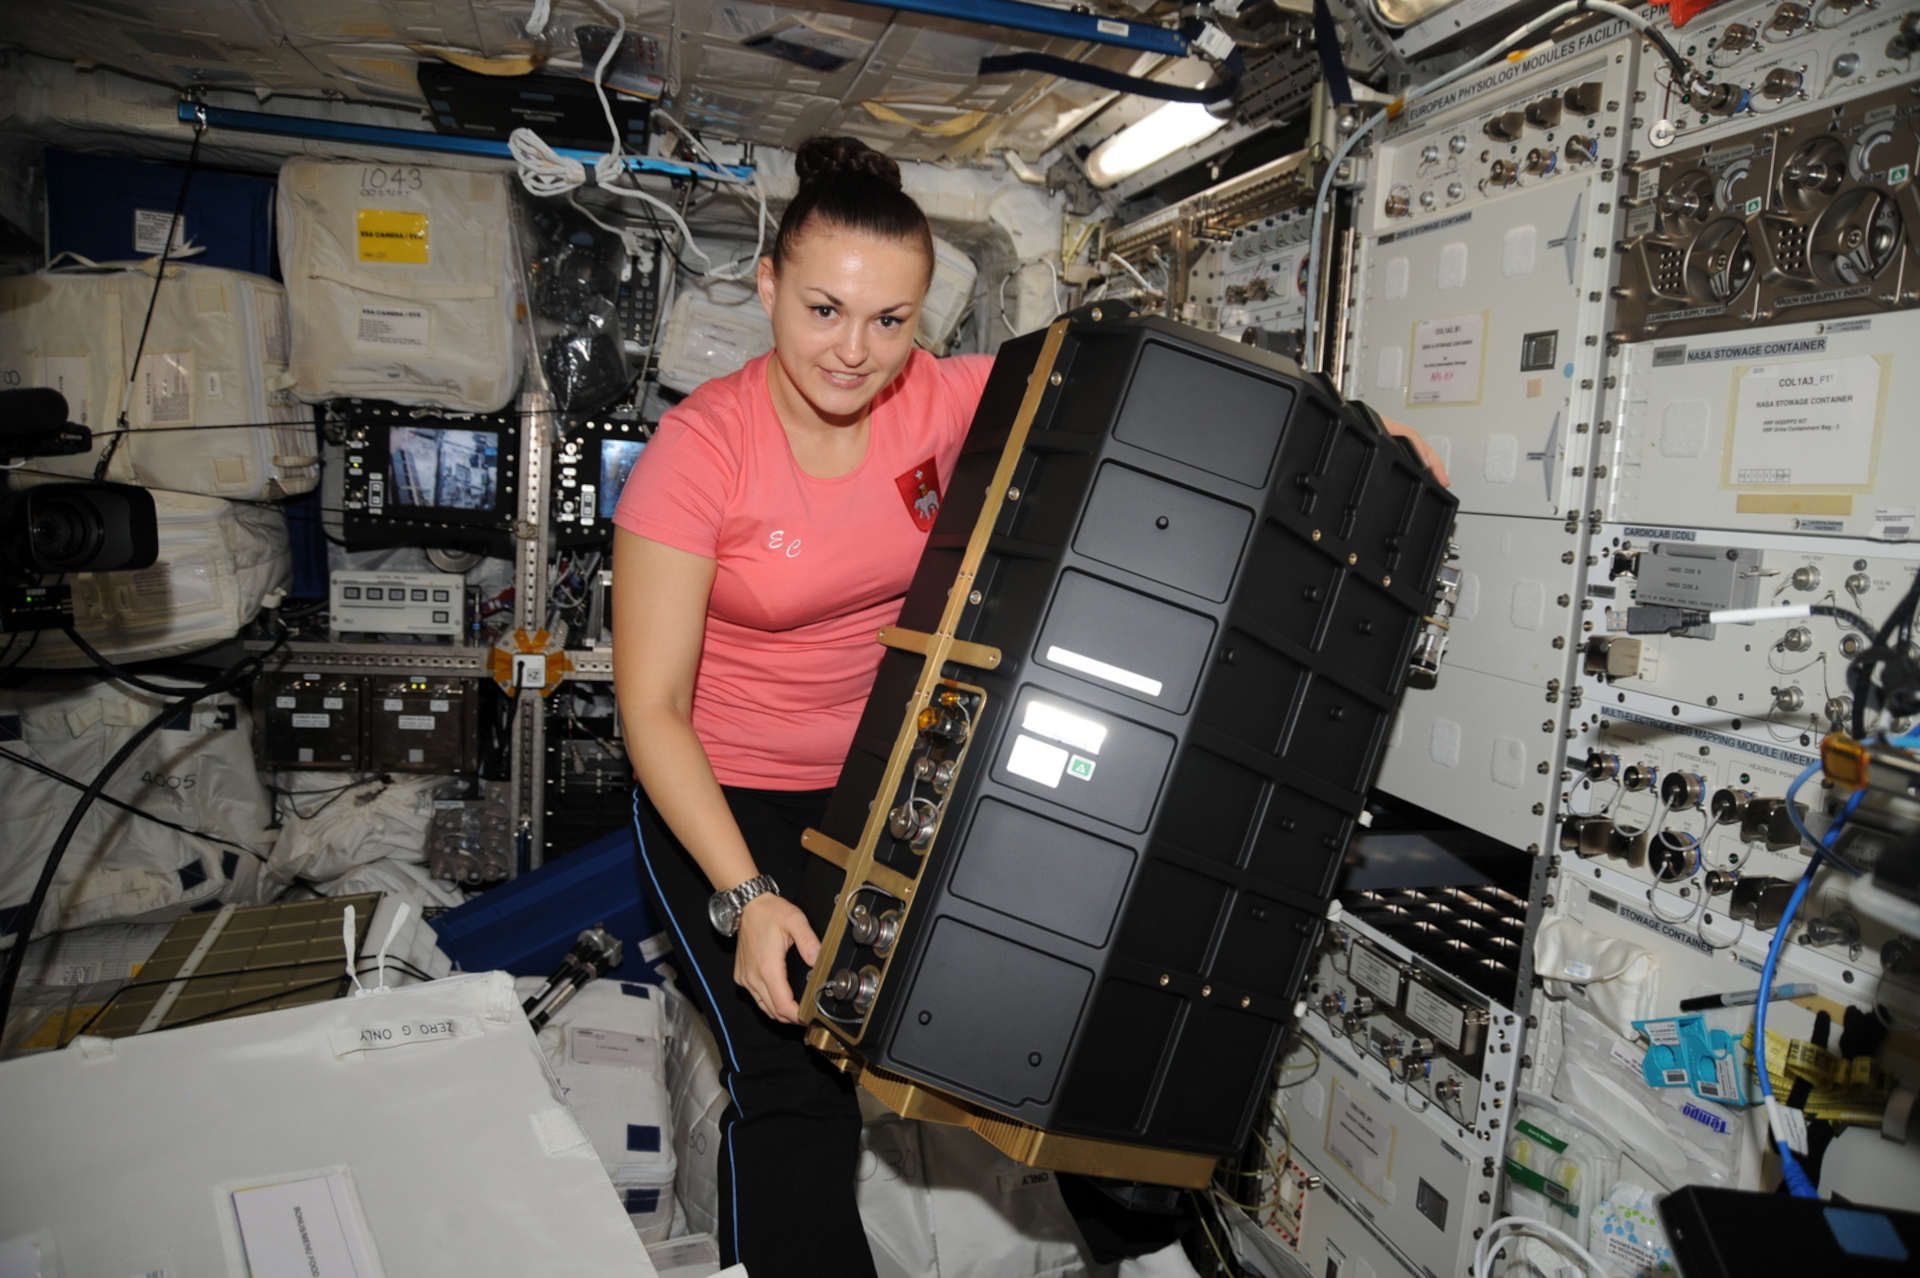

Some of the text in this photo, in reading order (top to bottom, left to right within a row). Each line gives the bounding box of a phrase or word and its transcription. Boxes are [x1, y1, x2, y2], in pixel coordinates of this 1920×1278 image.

[1409, 93, 1458, 120] EUROPEAN
[1457, 65, 1521, 103] PHYSIOLOGY
[1520, 44, 1577, 76] MODULES
[361, 167, 424, 190] 1043
[1687, 338, 1825, 362] NASA STOWAGE CONTAINER
[1756, 394, 1854, 408] NASA STOWAGE CONTAINER
[1623, 526, 1672, 539] CARDIOLAB
[1674, 723, 1694, 738] EEG
[1694, 727, 1735, 748] MAPPING
[1736, 739, 1779, 759] MODULE
[1619, 905, 1714, 957] STOWAGE CONTAINER
[360, 1021, 456, 1041] ZERO G ONLY
